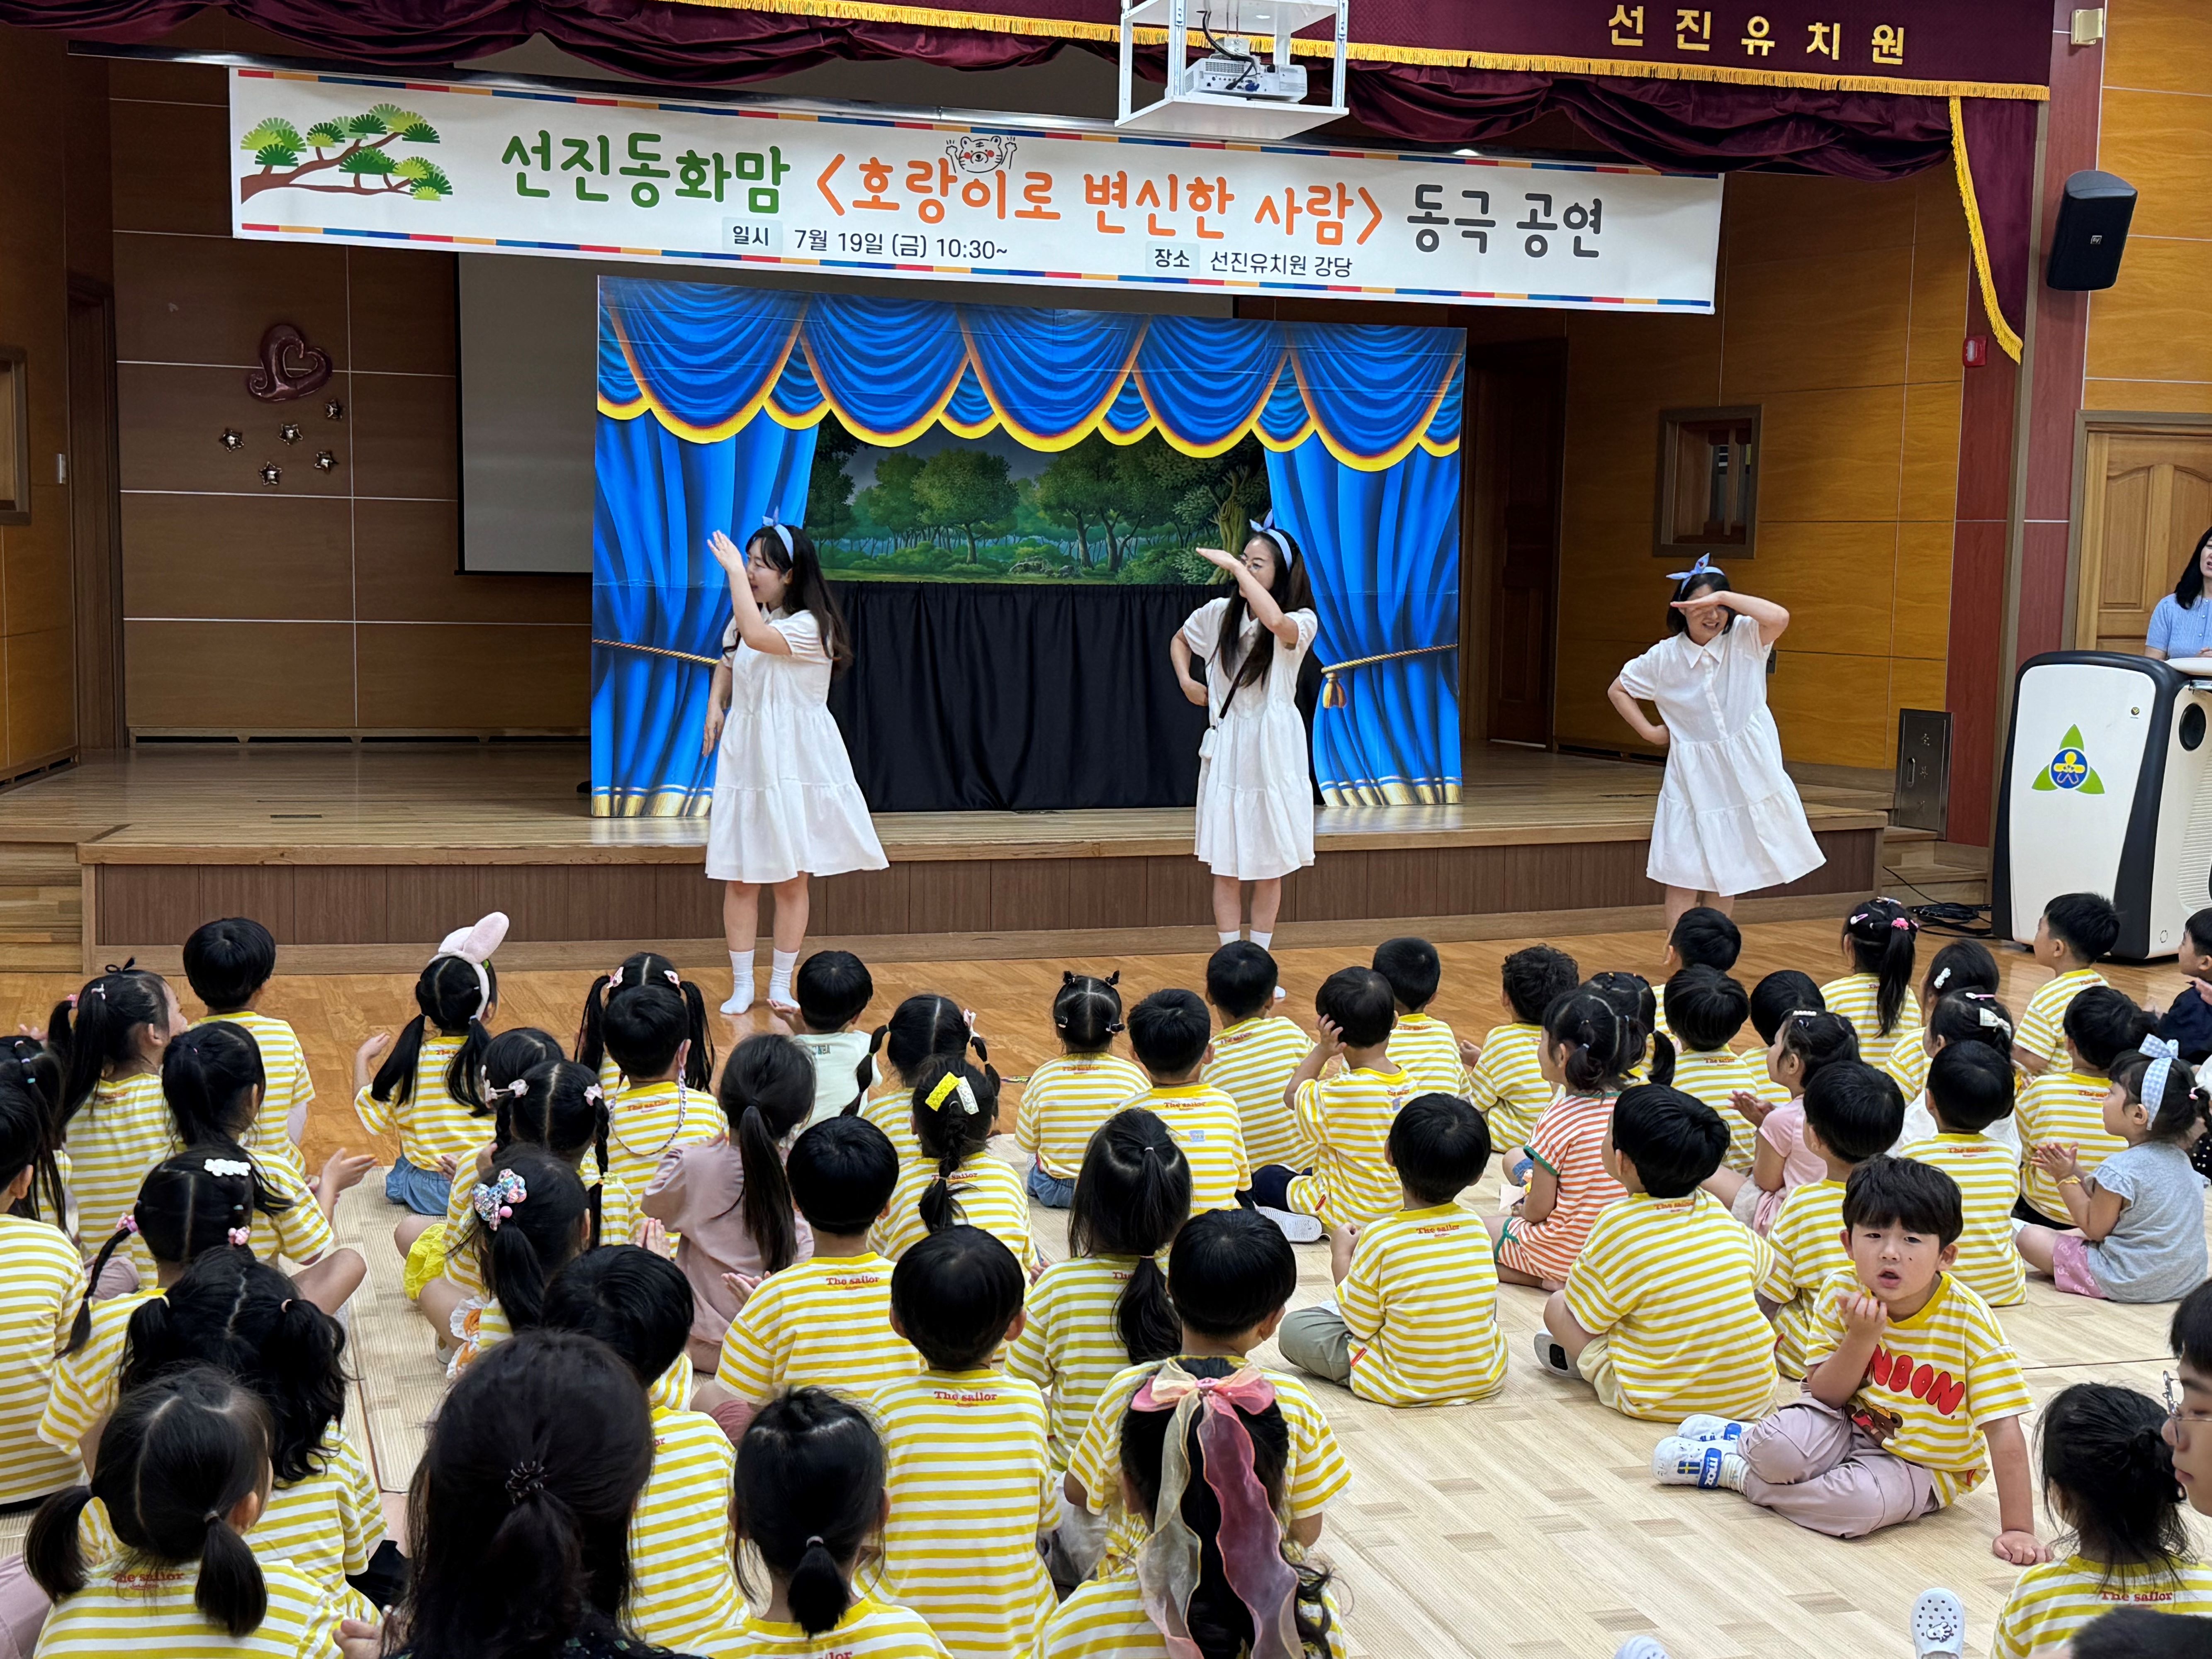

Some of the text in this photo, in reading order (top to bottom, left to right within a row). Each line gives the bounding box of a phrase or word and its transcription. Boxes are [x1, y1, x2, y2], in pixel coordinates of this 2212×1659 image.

[501, 130, 790, 214] 선진동화맘
[1084, 171, 1234, 239] 변신한
[1254, 183, 1382, 246] 사람>
[1407, 183, 1497, 254] 동극
[1516, 192, 1603, 258] 공연
[732, 225, 1008, 259] 일시 7월 19일 (금) 10:30~
[1154, 248, 1353, 278] 장소 선진유치원 강당
[825, 1277, 847, 1286] The
[934, 1391, 998, 1402] The sailor
[2100, 1591, 2130, 1602] The
